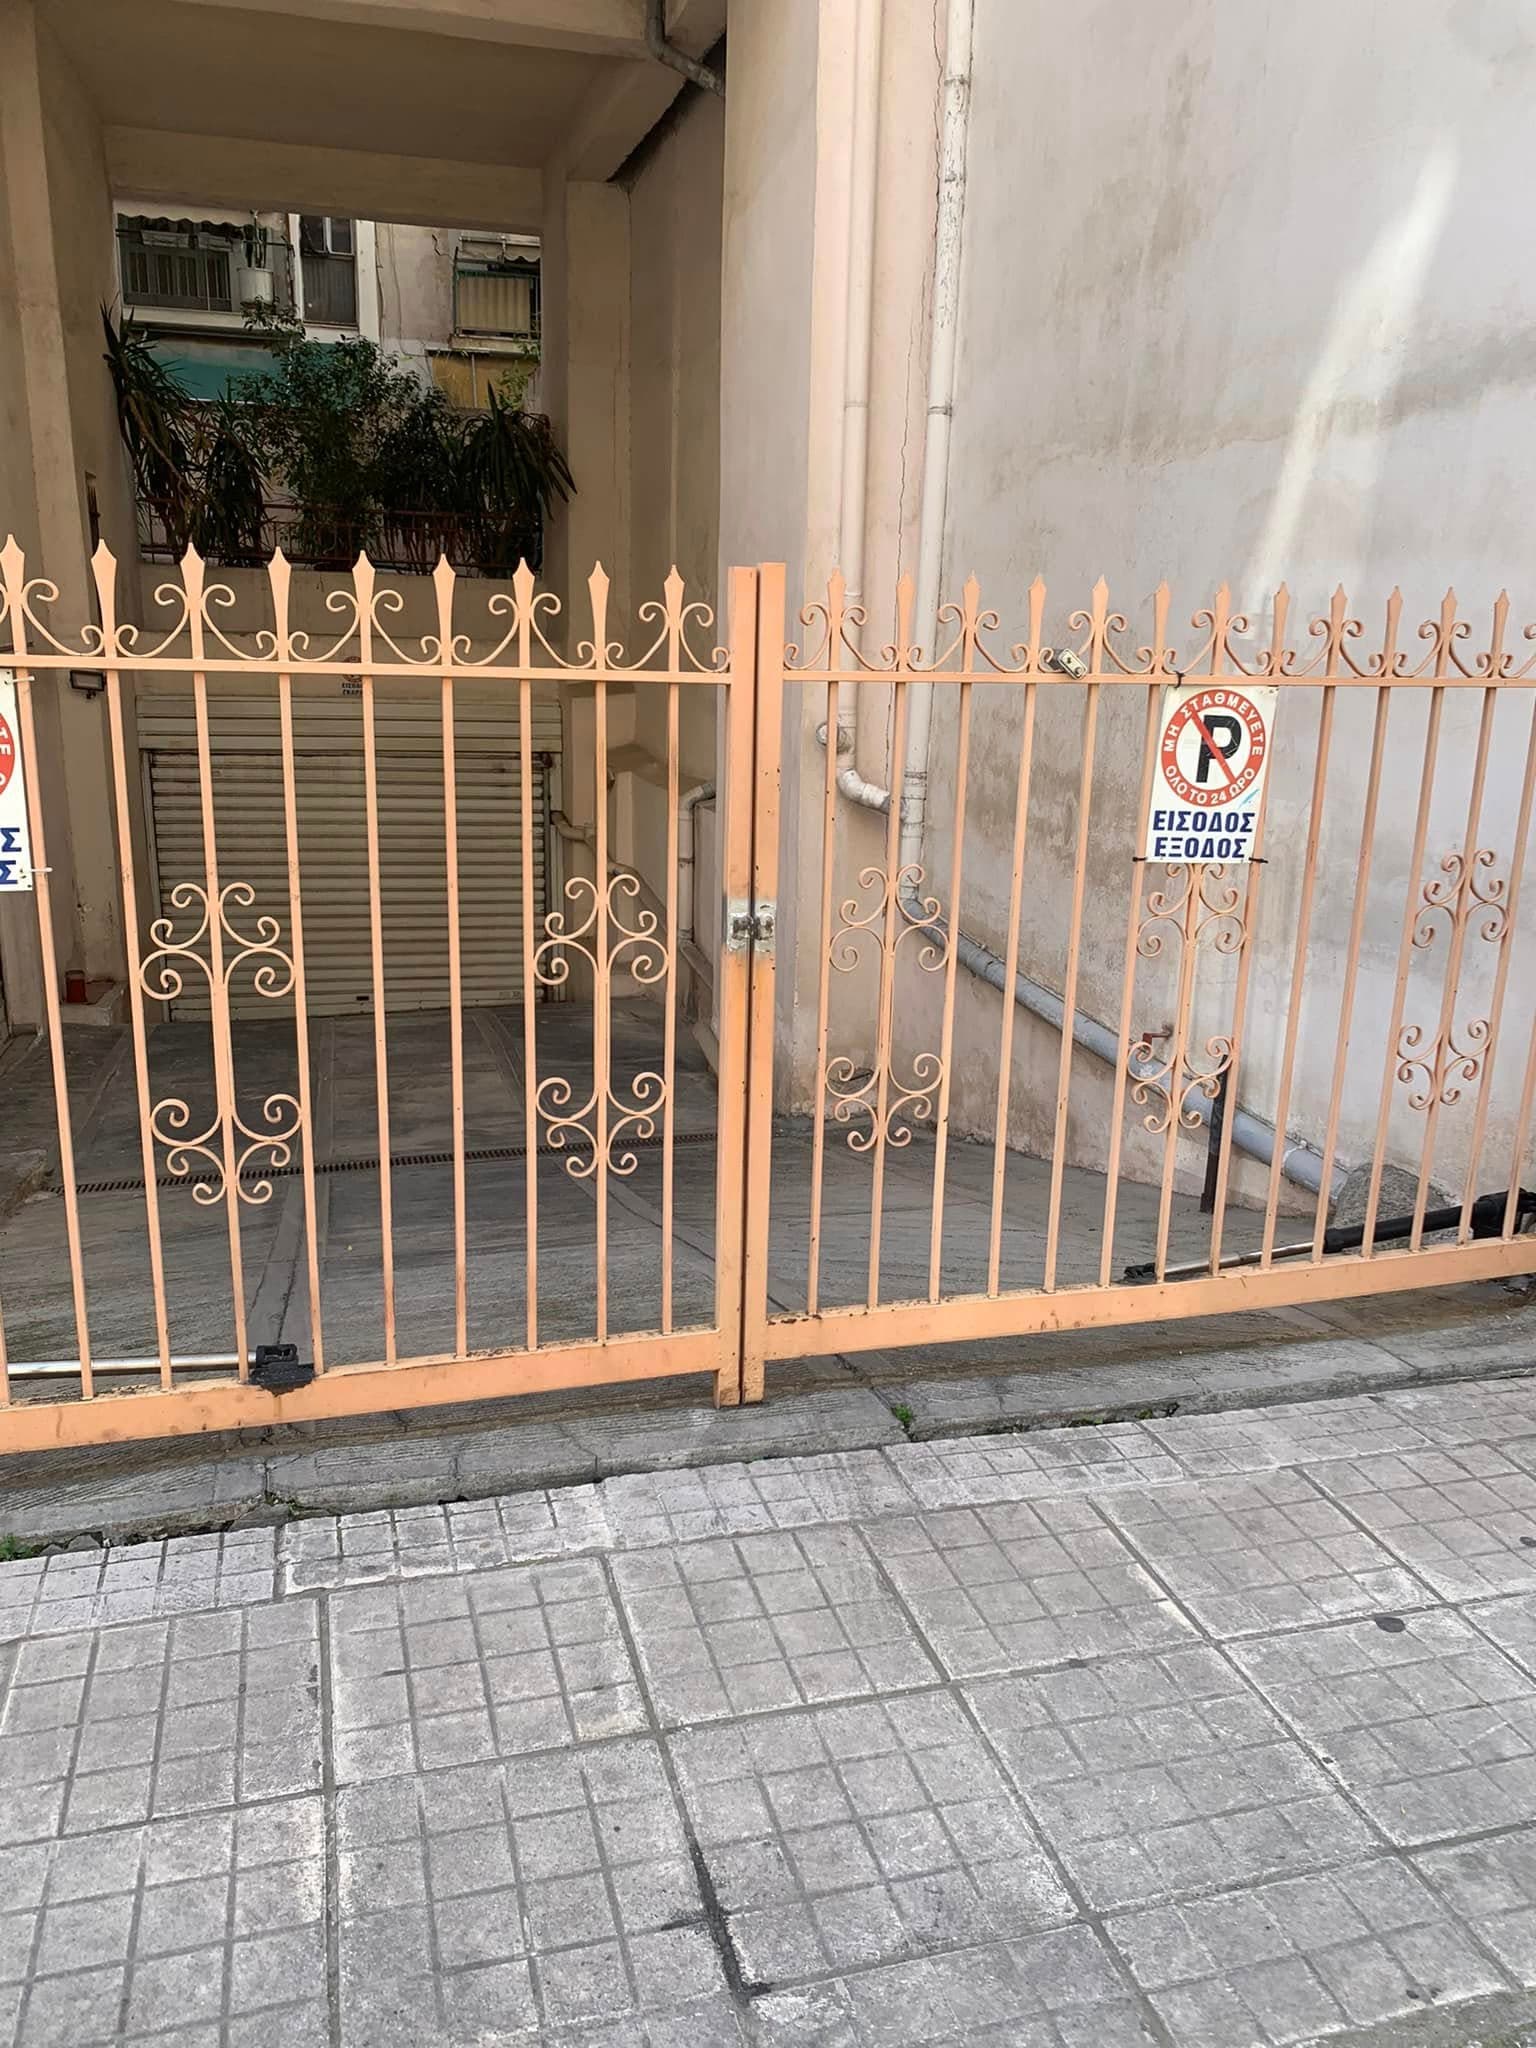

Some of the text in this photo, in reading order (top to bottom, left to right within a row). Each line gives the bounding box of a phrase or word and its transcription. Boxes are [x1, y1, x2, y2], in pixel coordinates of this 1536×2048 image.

[1164, 693, 1263, 756] ΜΗ ΣΤΑΘΜΕΥΕΤΕ
[1165, 765, 1255, 804] ΟΛΟ ΤΟ 24 ΩΡΟ
[1152, 810, 1255, 832] ΕΙΣΟΔΟΣ
[1154, 837, 1247, 858] ΕΞΟΔΟΣ
